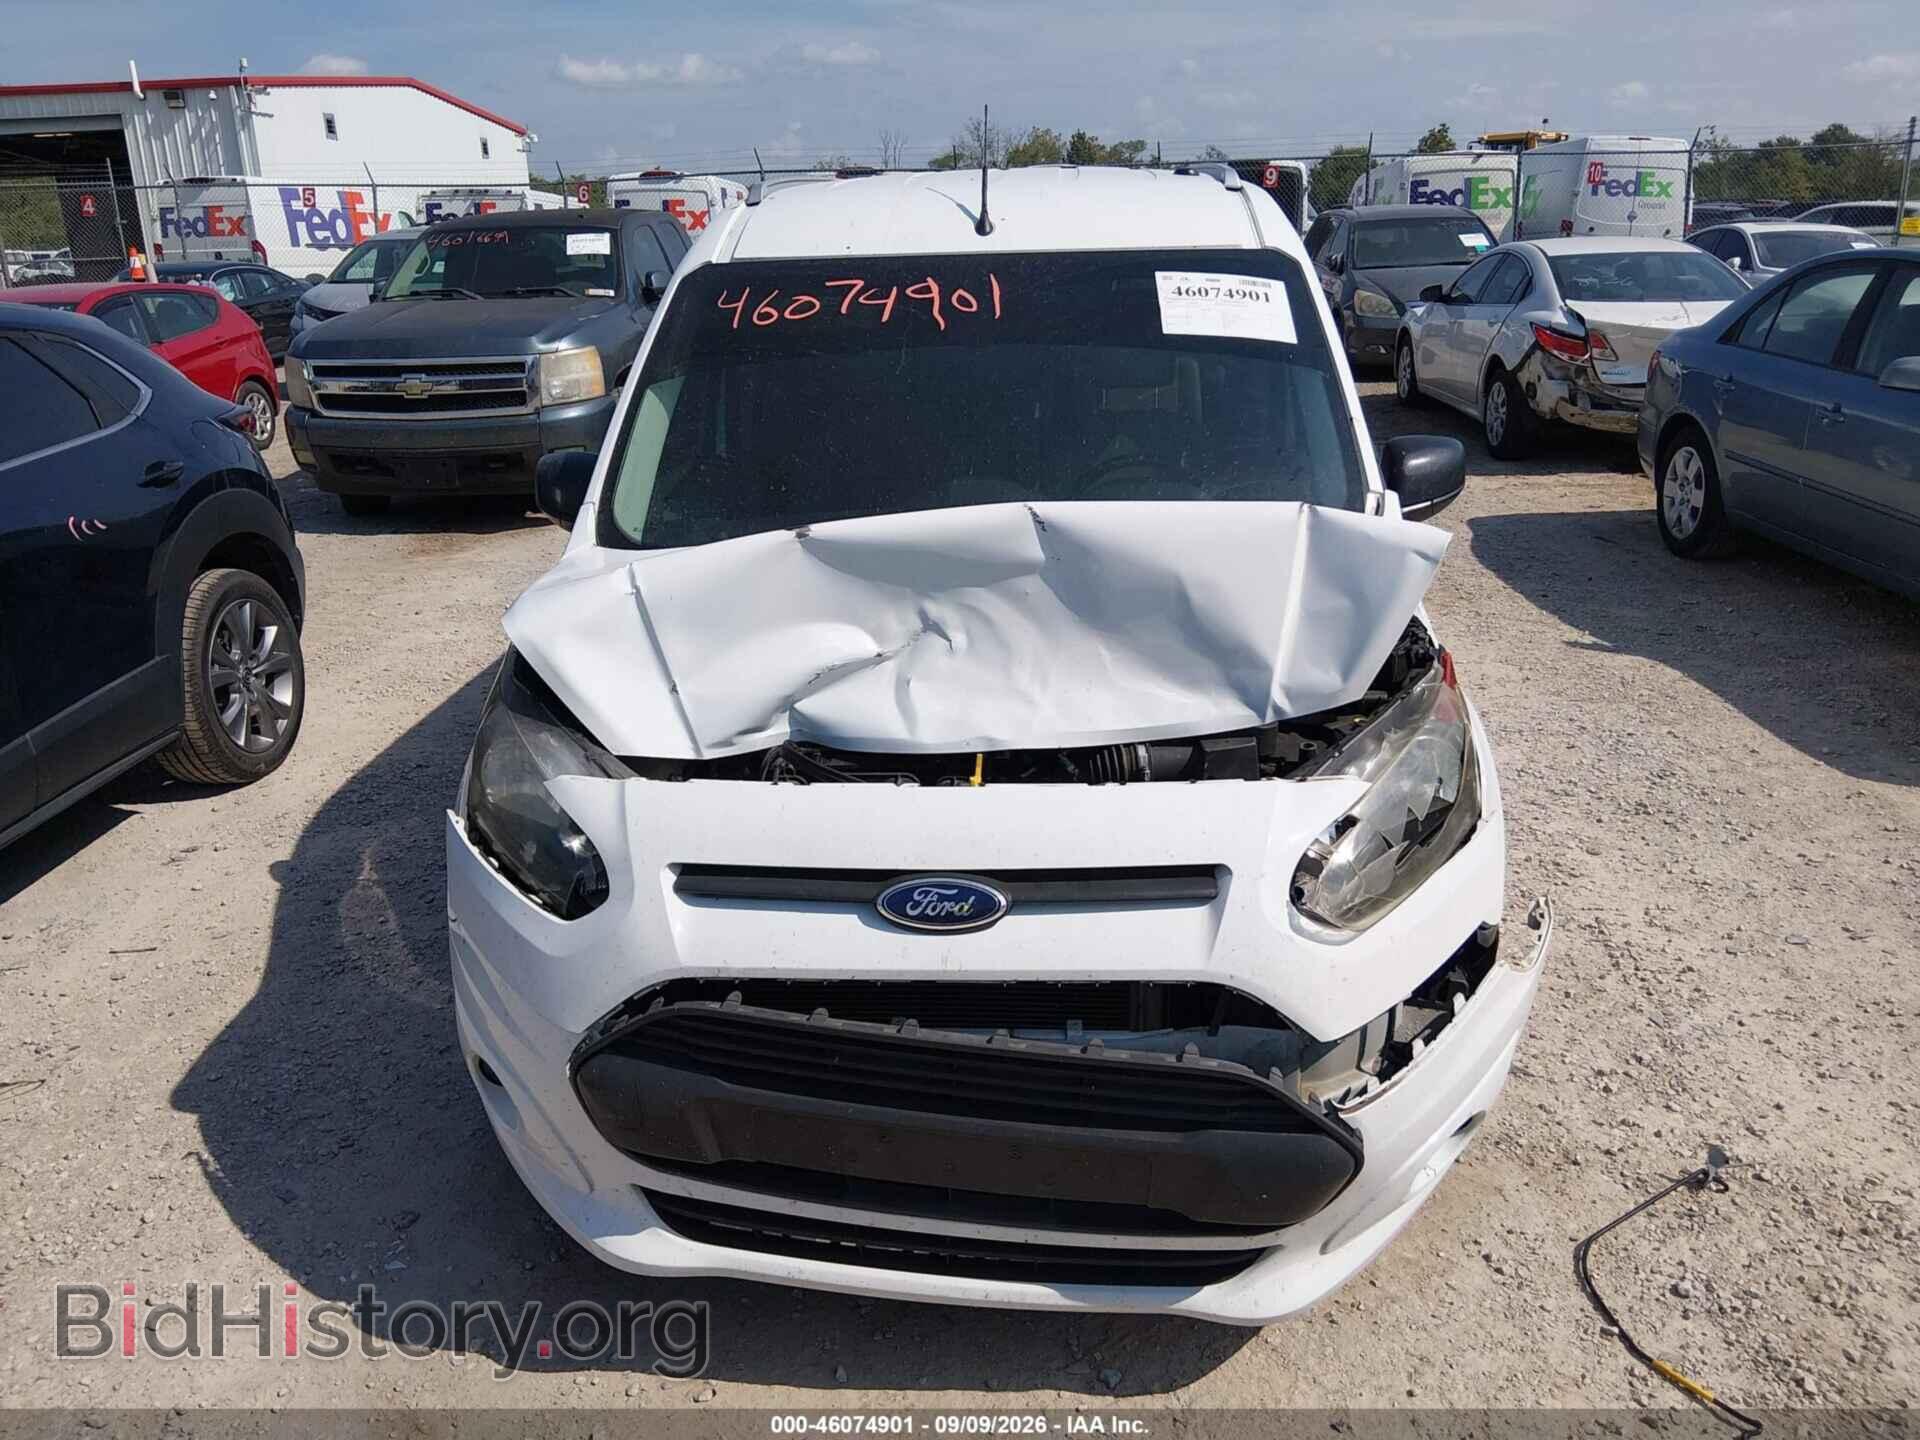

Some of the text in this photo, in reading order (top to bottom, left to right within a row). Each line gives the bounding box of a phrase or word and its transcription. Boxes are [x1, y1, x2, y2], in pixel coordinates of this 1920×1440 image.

[1266, 166, 1278, 185] 9
[1589, 164, 1602, 182] 10
[303, 188, 314, 207] 5
[578, 185, 589, 202] 6
[82, 198, 95, 214] 4
[159, 206, 248, 238] FedEx
[279, 187, 392, 251] FedEx
[717, 273, 1001, 331] 46074901
[1171, 285, 1271, 303] 46074901
[905, 887, 976, 917] Ford
